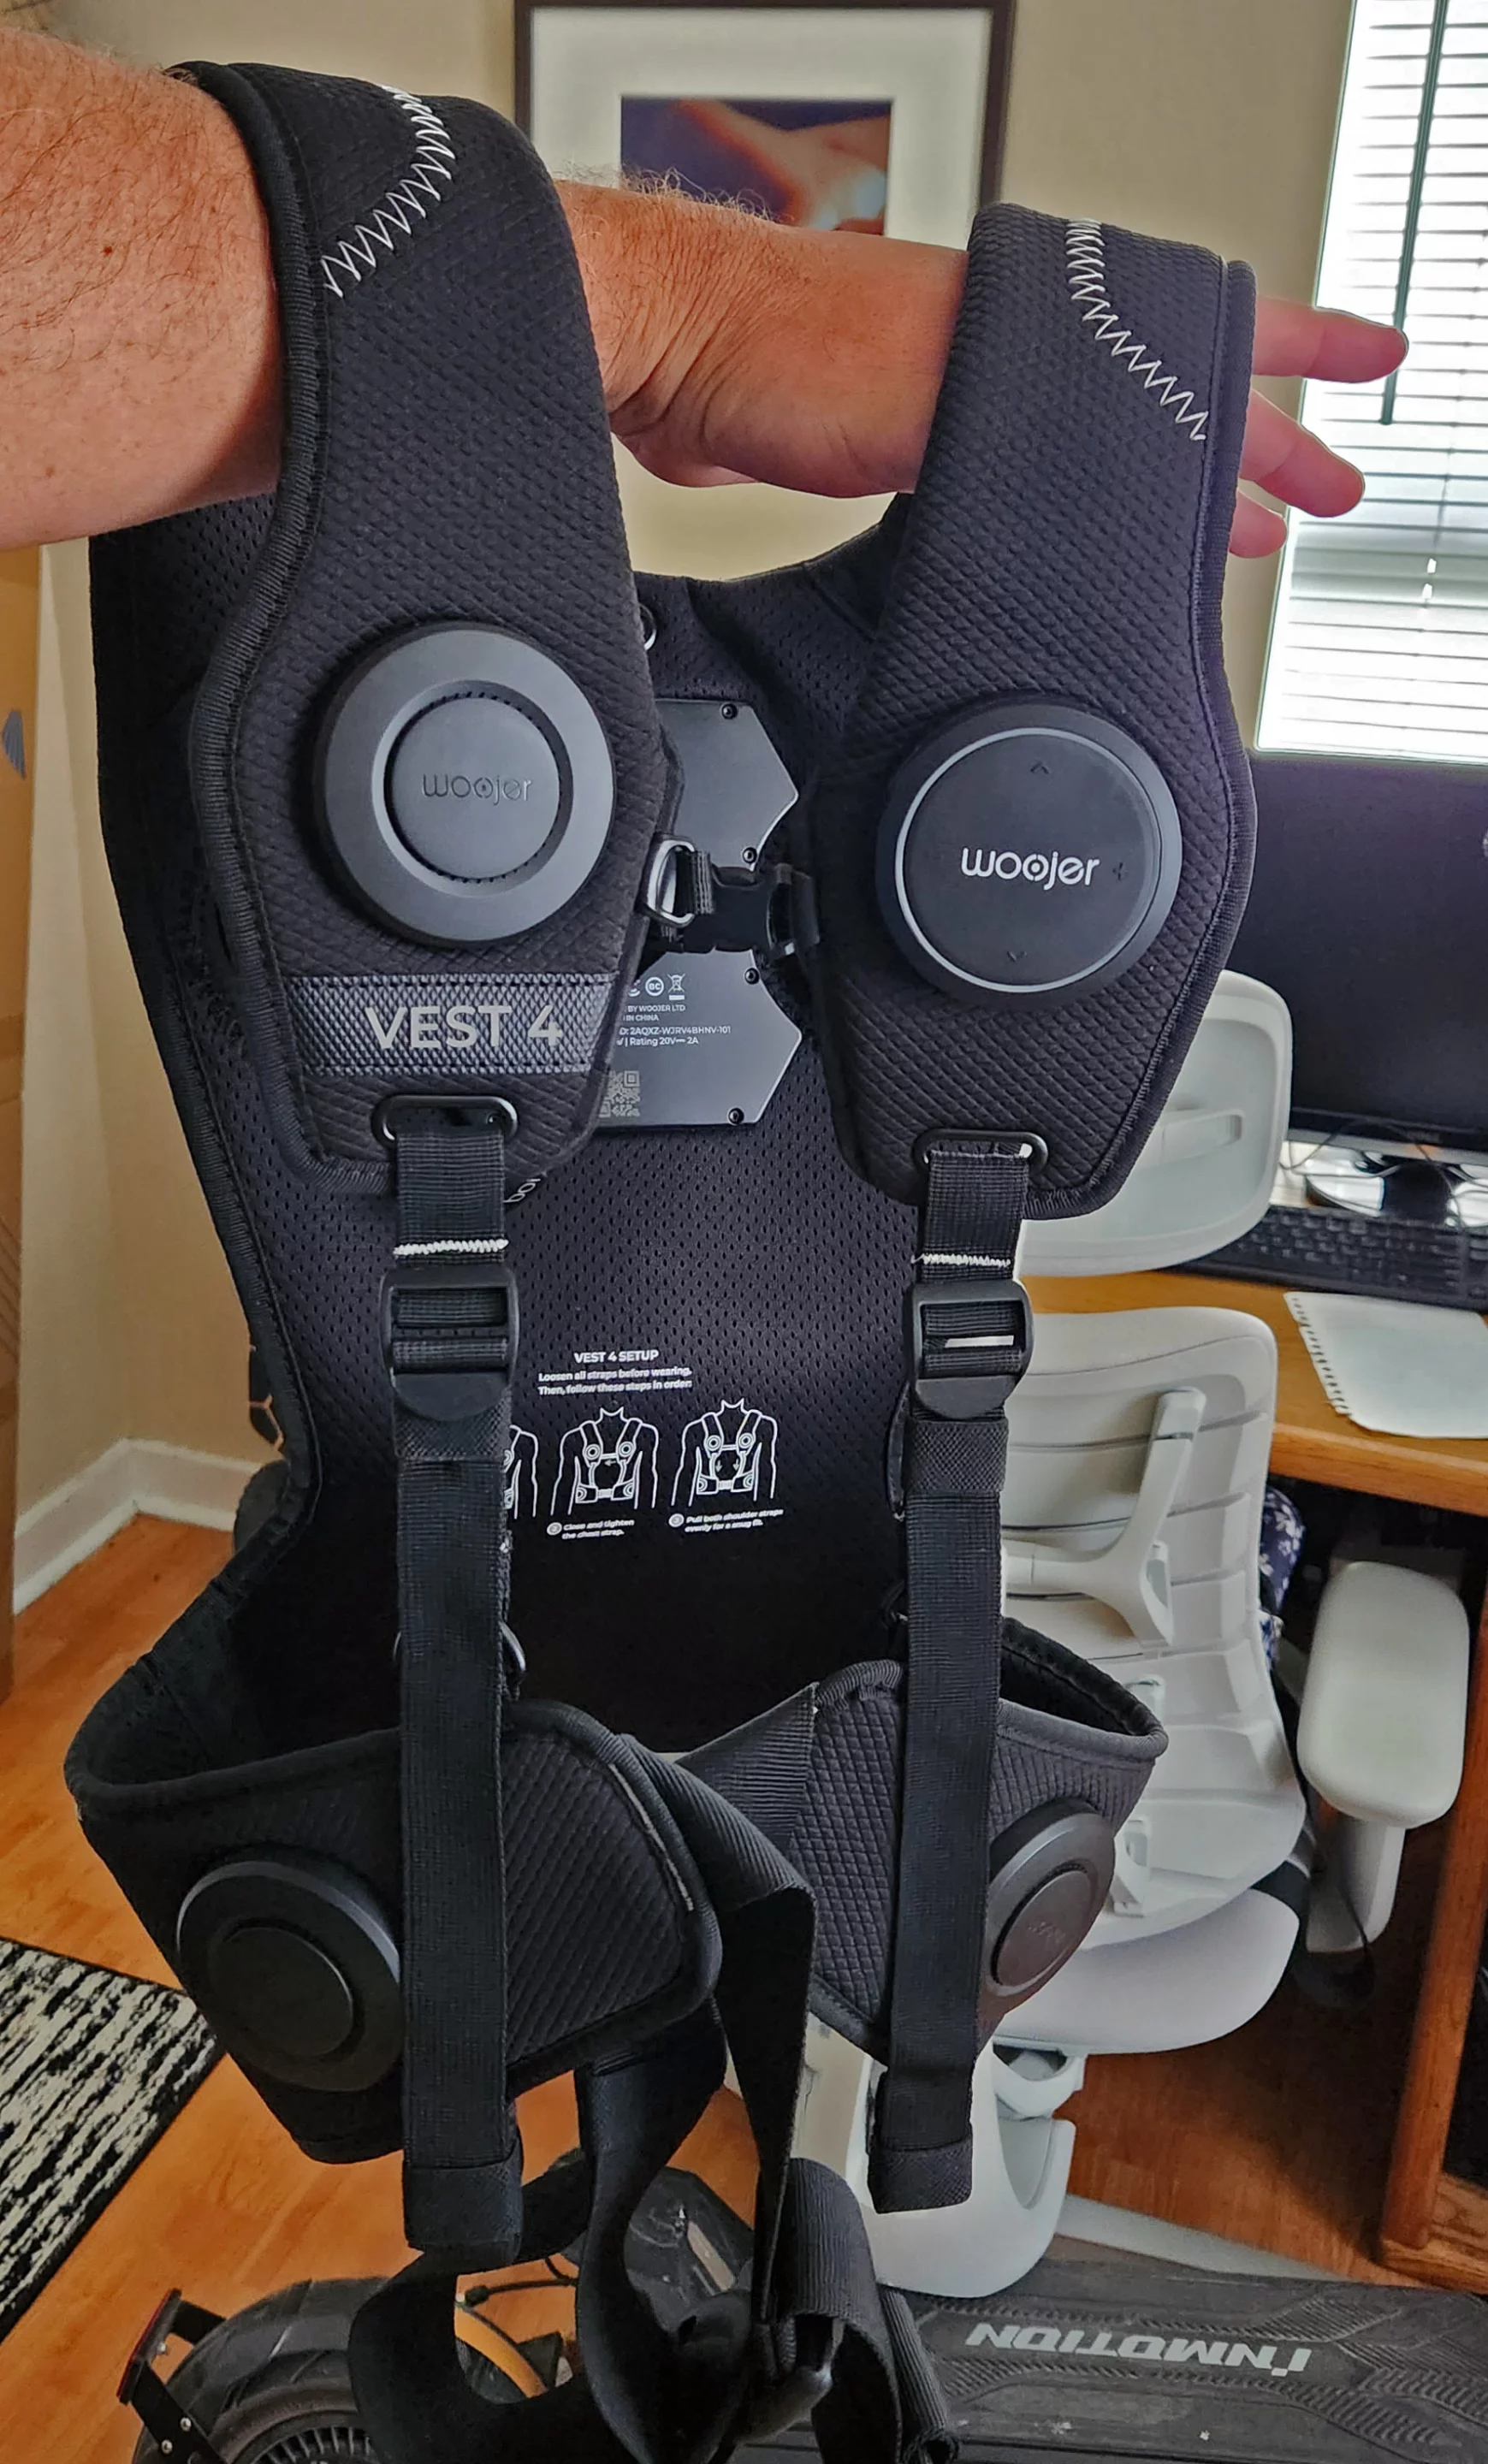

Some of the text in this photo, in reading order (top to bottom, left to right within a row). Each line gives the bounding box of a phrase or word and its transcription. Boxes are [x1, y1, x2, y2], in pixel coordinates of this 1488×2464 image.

[422, 773, 533, 806] woojer
[961, 847, 1100, 891] woojer
[365, 1004, 564, 1051] VEST 4
[630, 1037, 658, 1046] Rating
[687, 1036, 699, 1045] 2A
[574, 1349, 659, 1364] VEST 4 SETUP
[538, 1372, 573, 1383] Loosen
[574, 1371, 586, 1381] all
[587, 1370, 617, 1381] straps
[618, 1368, 649, 1378] before
[566, 1383, 596, 1395] follow
[597, 1383, 625, 1393] these
[625, 1382, 652, 1392] steps
[652, 1379, 662, 1389] in
